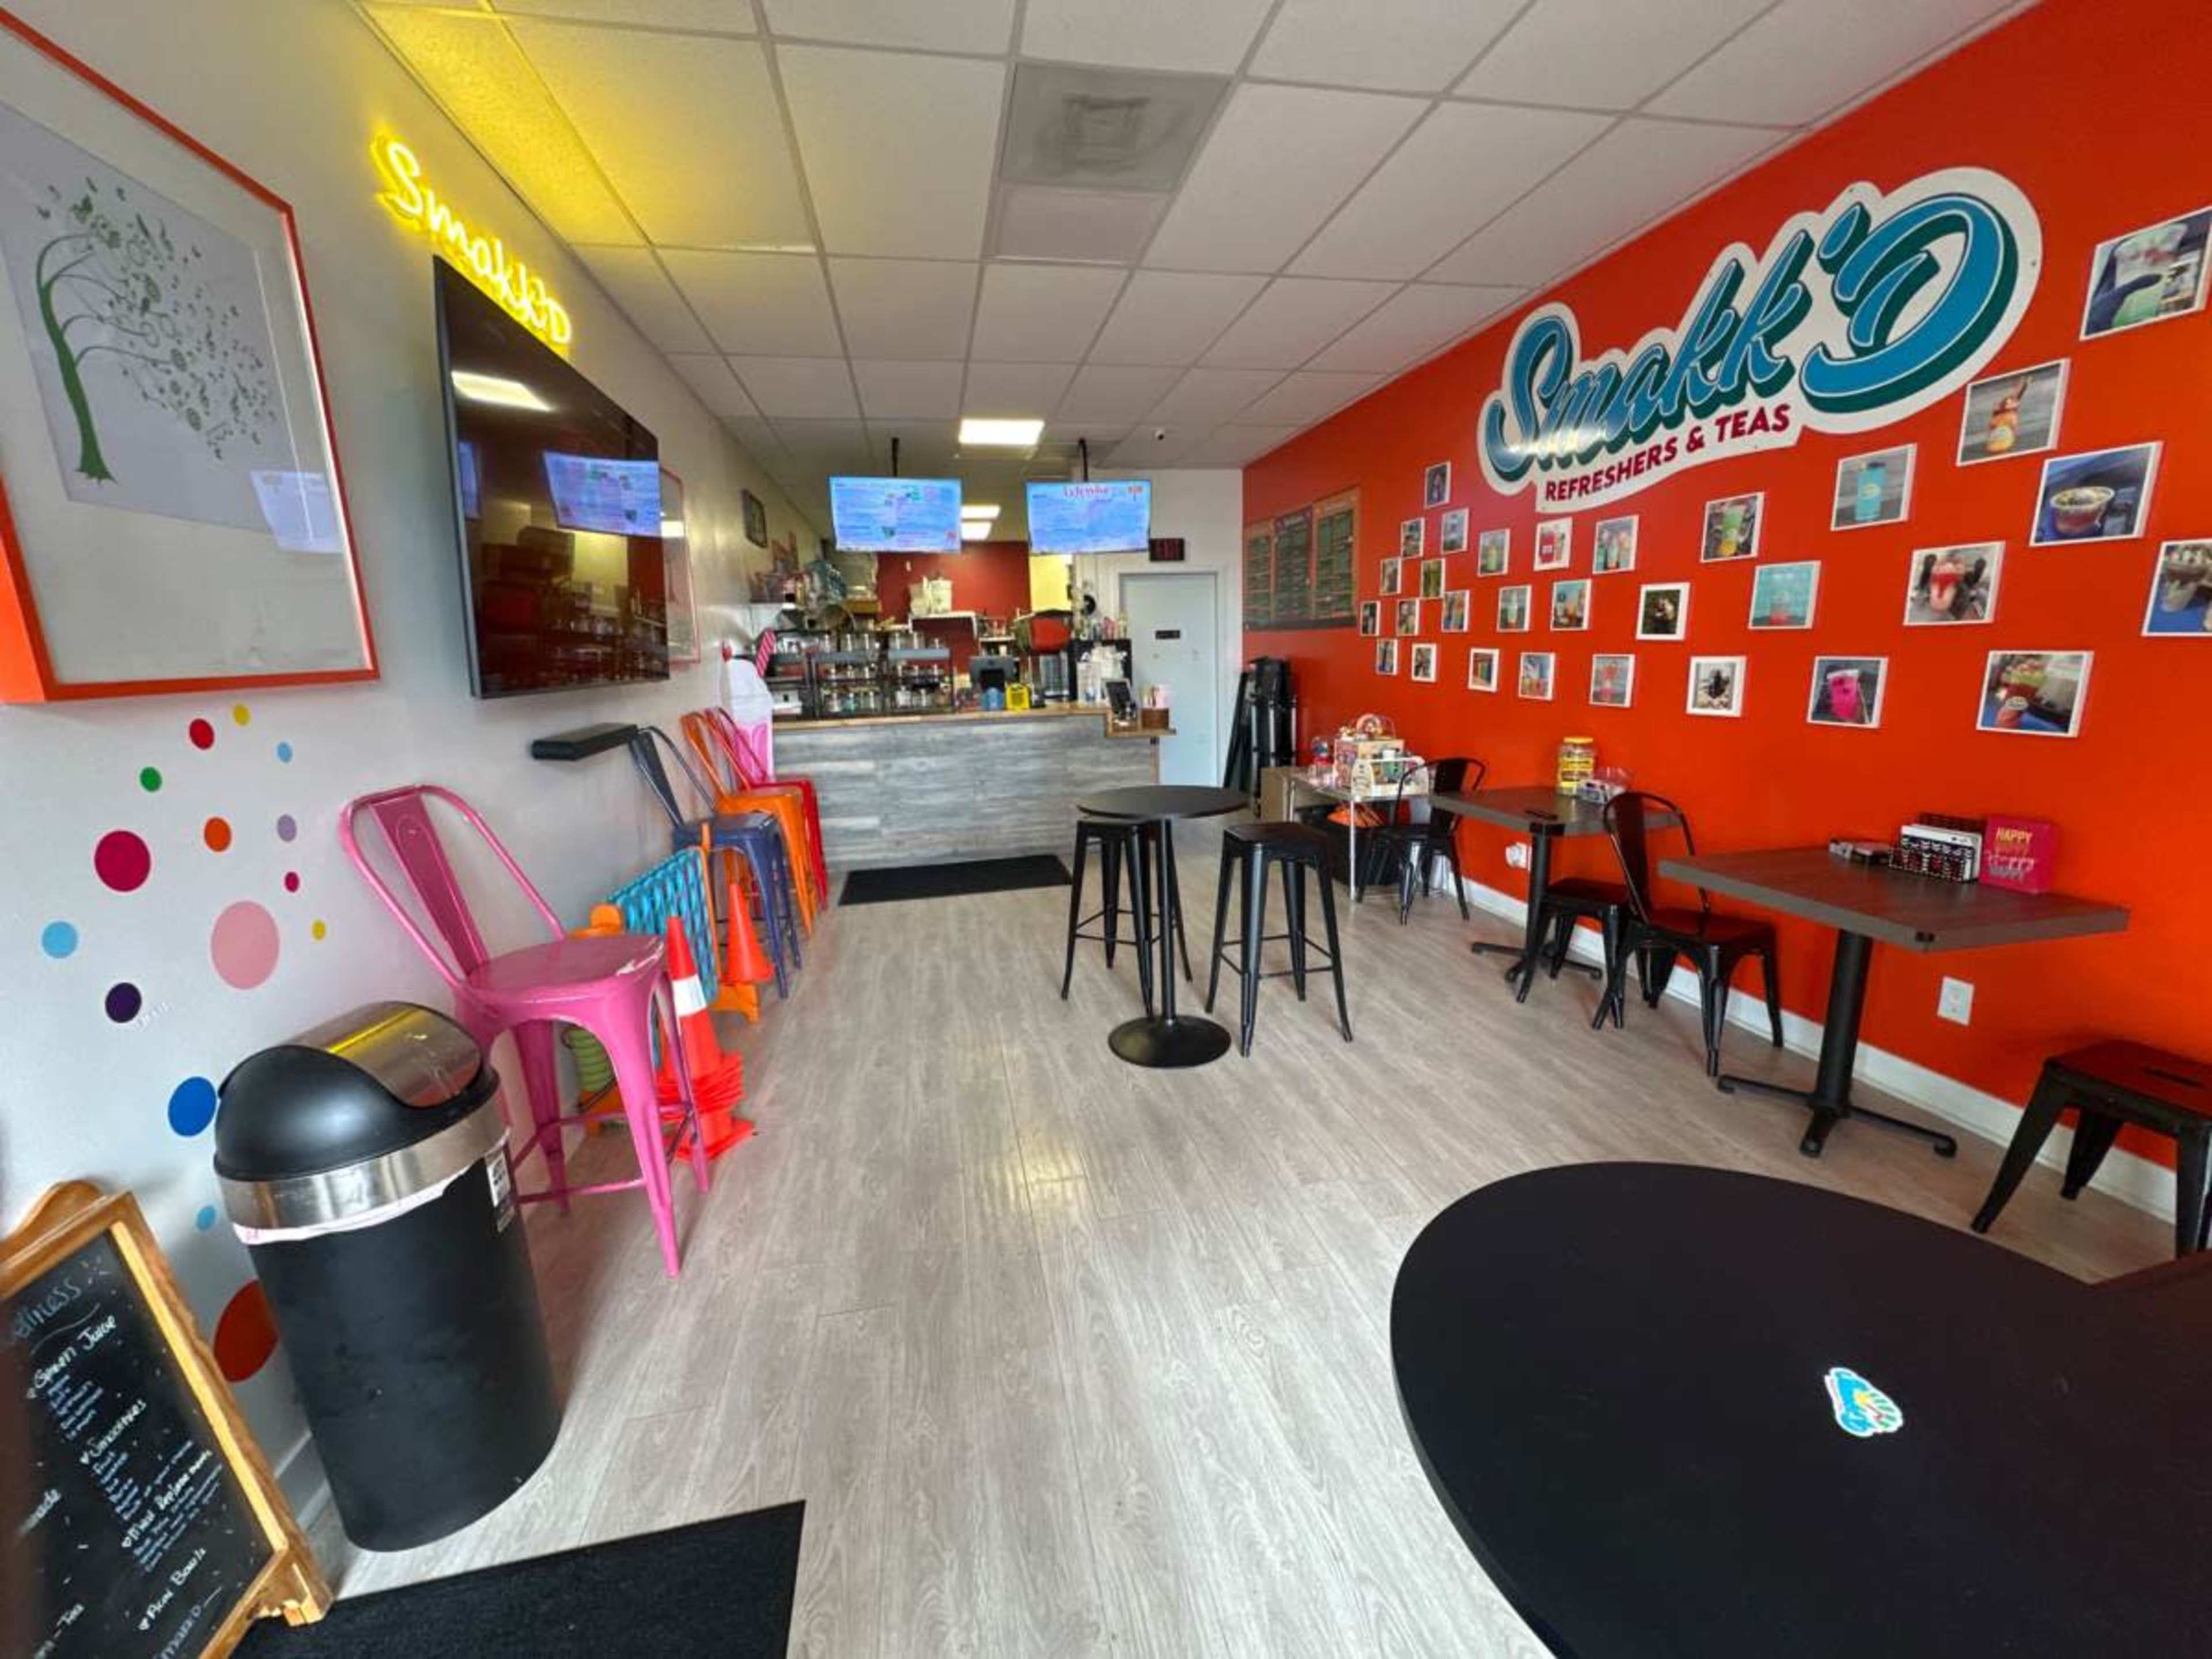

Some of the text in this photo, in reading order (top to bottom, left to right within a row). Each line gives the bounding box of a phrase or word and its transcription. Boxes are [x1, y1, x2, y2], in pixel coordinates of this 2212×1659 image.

[1484, 192, 2019, 482] Smakk'D
[1544, 404, 1791, 501] REFRESHERS & TEAS
